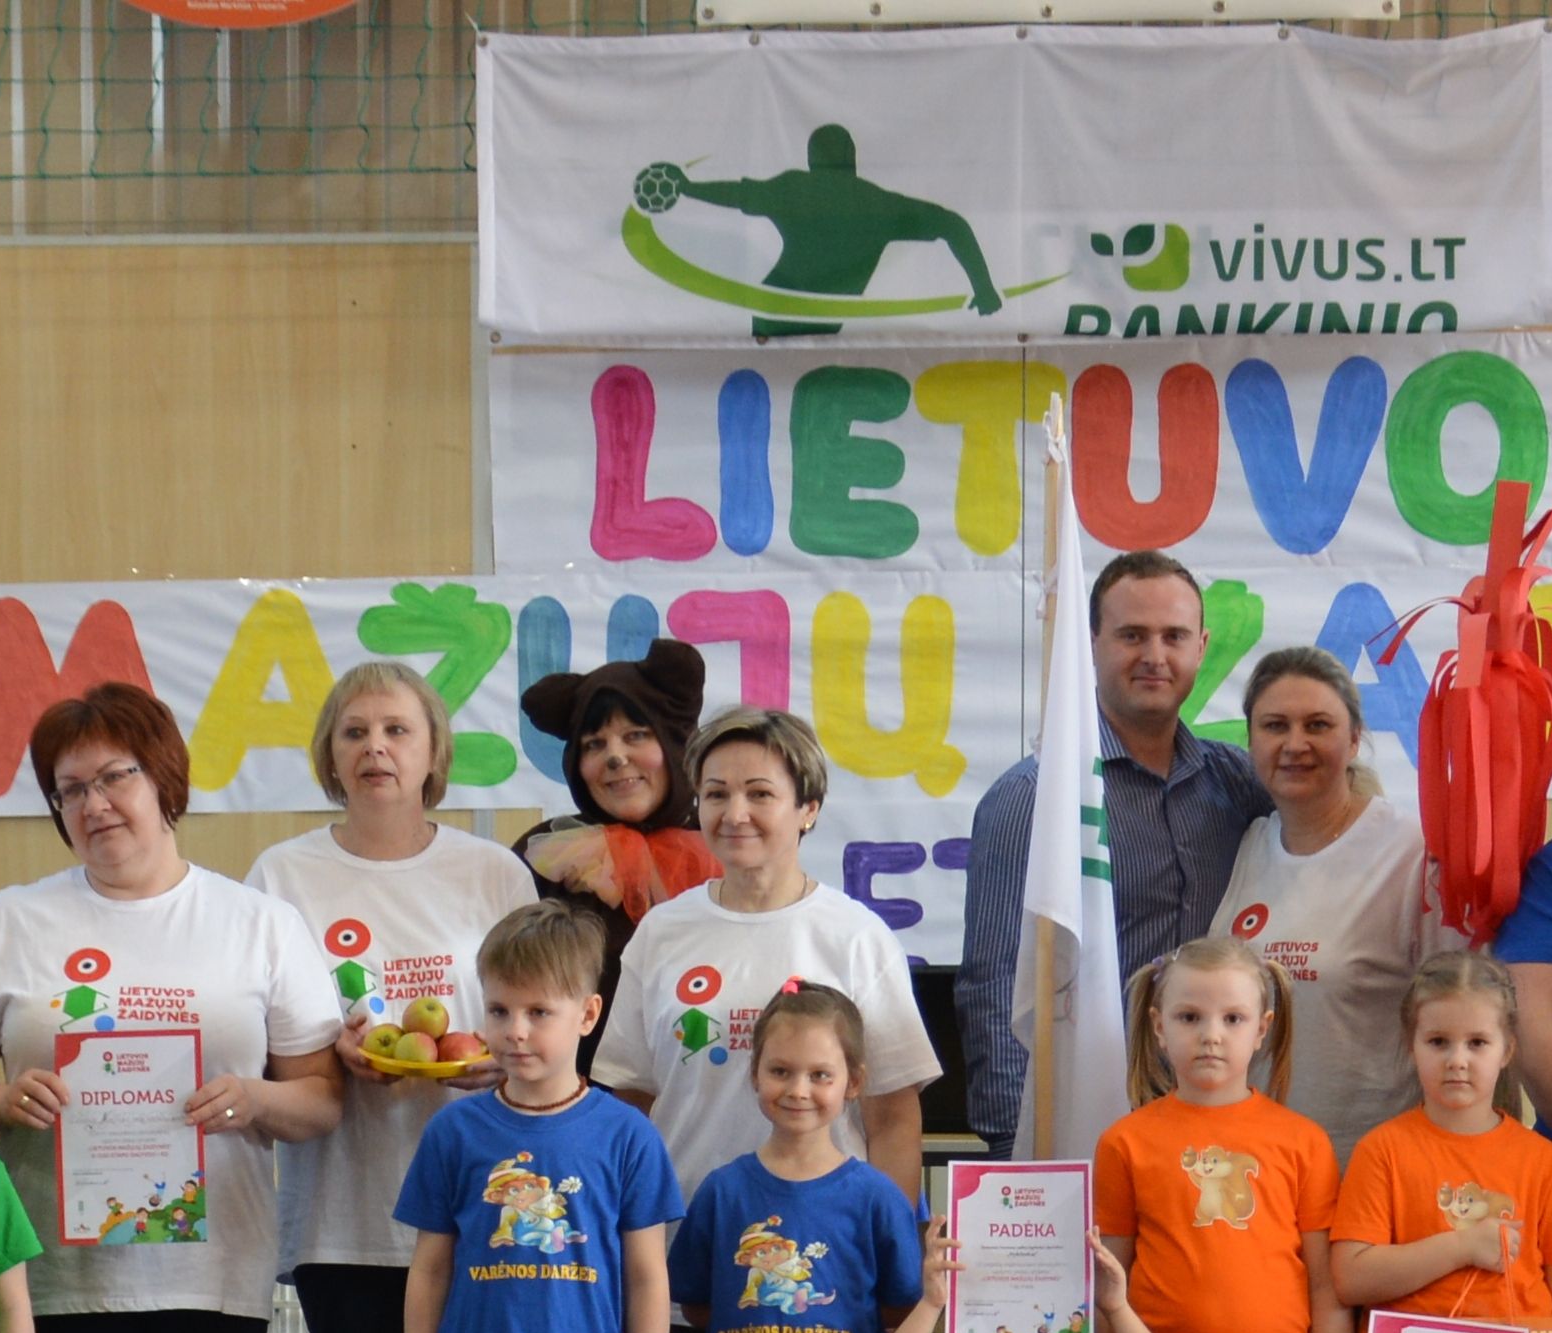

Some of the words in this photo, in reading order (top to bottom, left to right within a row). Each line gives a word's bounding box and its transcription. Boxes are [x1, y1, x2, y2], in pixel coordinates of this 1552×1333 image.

[1264, 941, 1319, 953] LIETUVOS
[383, 954, 454, 972] LIETUVOS
[119, 986, 196, 998] LIETUVOS
[81, 1089, 175, 1106] DIPLOMAS
[989, 1220, 1057, 1238] PADĖKA
[469, 1260, 537, 1281] VARĖNOS
